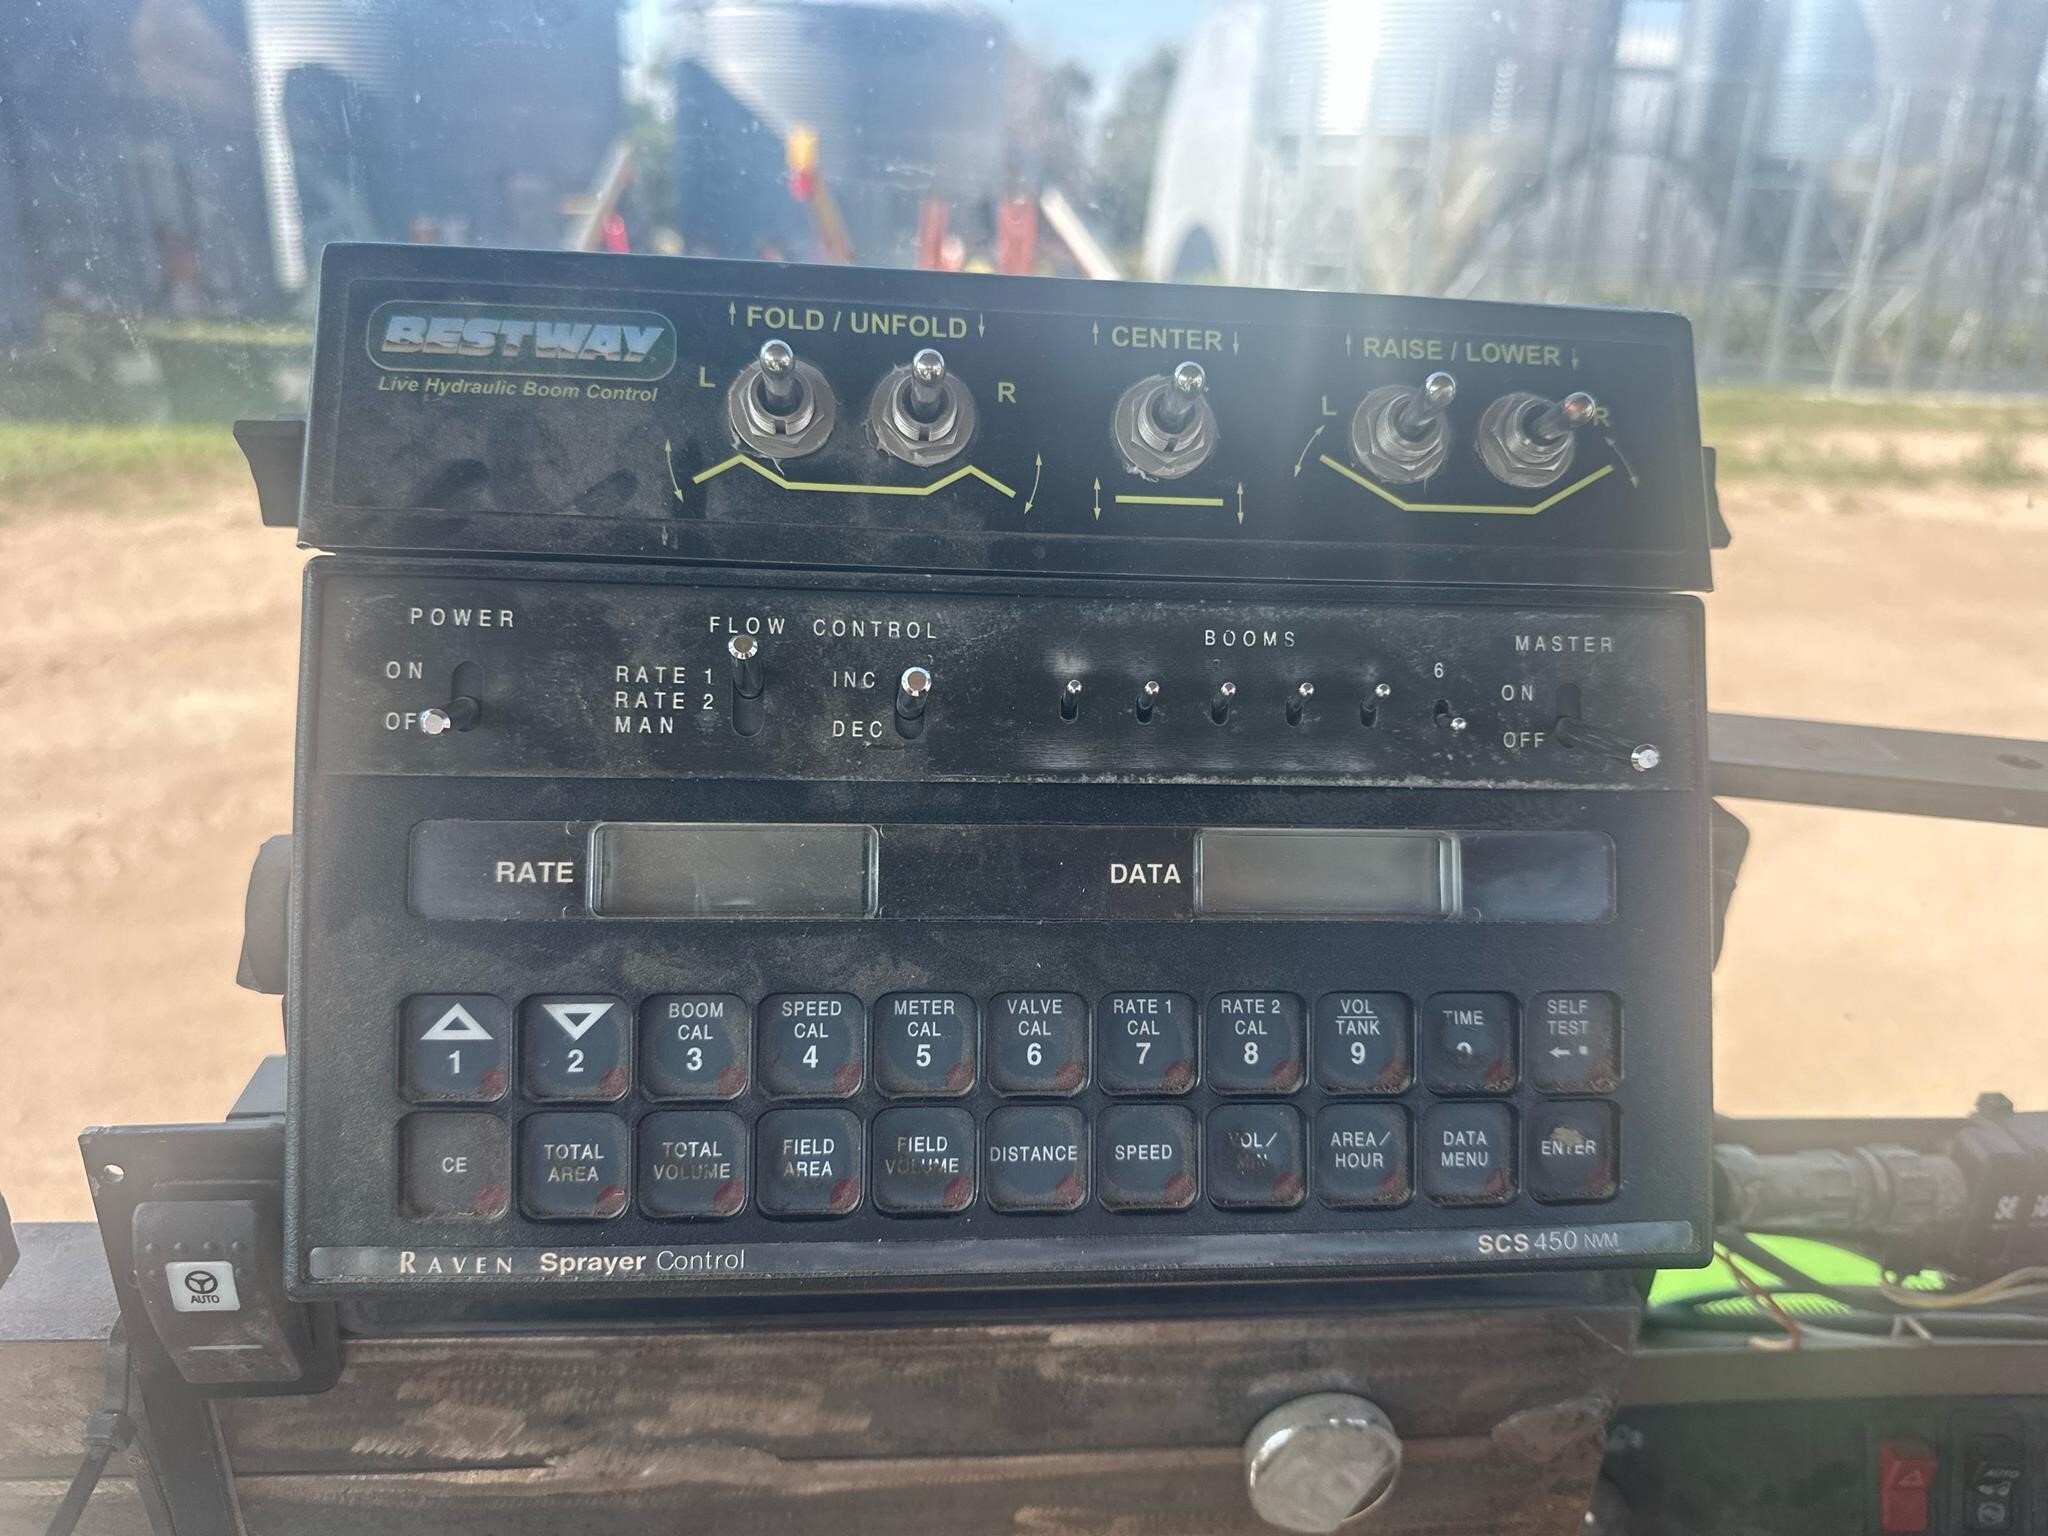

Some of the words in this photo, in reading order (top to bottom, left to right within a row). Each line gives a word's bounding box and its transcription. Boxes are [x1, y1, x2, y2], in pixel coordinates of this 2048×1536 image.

[746, 306, 825, 332] FOLD
[849, 312, 969, 340] UNFOLD
[382, 315, 665, 363] BESTWAY
[1111, 325, 1223, 352] CENTER
[1363, 336, 1443, 362] RAISE
[1465, 342, 1562, 367] LOWER
[700, 366, 716, 388] L
[378, 376, 420, 392] Live
[424, 377, 518, 397] Hydraulic
[522, 381, 580, 398] Boom
[587, 384, 659, 402] Control
[998, 381, 1016, 404] R
[1321, 395, 1337, 417] L
[410, 607, 516, 629] POWER
[709, 615, 787, 637] FLOW
[812, 618, 938, 641] CONTROL
[1204, 628, 1298, 649] BOOMS
[1515, 634, 1615, 655] MASTER
[385, 661, 424, 681] ON
[615, 665, 686, 685] RATE
[704, 669, 713, 685] 1
[1434, 661, 1445, 680] 6
[832, 671, 877, 690] INC
[615, 691, 686, 711] RATE
[702, 693, 715, 711] 2
[1501, 683, 1535, 702] ON
[385, 711, 418, 731] OF
[615, 715, 674, 735] MAN
[832, 720, 884, 740] DEC
[1502, 730, 1546, 750] OFF
[495, 860, 575, 885] RATE
[1109, 862, 1182, 885] DATA
[668, 1001, 724, 1019] BOOM
[781, 1000, 842, 1017] SPEED
[894, 999, 955, 1016] METER
[1007, 998, 1063, 1015] VALVE
[1113, 998, 1158, 1014] RATE
[1165, 999, 1172, 1014] 1
[1220, 999, 1265, 1014] RATE
[1271, 999, 1281, 1014] 2
[1340, 998, 1374, 1015] VOL
[1546, 999, 1589, 1015] SELF
[1442, 1009, 1485, 1025] TIME
[677, 1023, 714, 1041] CAL
[793, 1022, 829, 1039] CAL
[907, 1021, 942, 1038] CAL
[1018, 1020, 1052, 1037] CAL
[1126, 1019, 1161, 1036] CAL
[1234, 1020, 1268, 1036] CAL
[1335, 1019, 1381, 1036] TANK
[1547, 1019, 1589, 1035] TEST
[448, 1051, 462, 1074] 1
[567, 1049, 585, 1073] 2
[686, 1048, 703, 1072] 3
[802, 1045, 819, 1068] 4
[916, 1044, 932, 1067] 5
[1026, 1042, 1043, 1066] 6
[1135, 1042, 1152, 1065] 7
[1243, 1042, 1259, 1065] 8
[1350, 1041, 1366, 1065] 9
[782, 1138, 835, 1155] FIELD
[897, 1135, 949, 1153] FIELD
[1331, 1130, 1391, 1148] AREA/
[1443, 1130, 1487, 1147] DATA
[544, 1143, 605, 1161] TOTAL
[662, 1141, 723, 1158] TOTAL
[990, 1145, 1078, 1163] DISTANCE
[1114, 1144, 1173, 1161] SPEED
[1441, 1151, 1489, 1167] MENU
[442, 1157, 468, 1174] CE
[783, 1161, 833, 1178] AREA
[1335, 1152, 1384, 1168] HOUR
[547, 1166, 600, 1183] AREA
[653, 1162, 731, 1180] VOLUME
[1477, 1233, 1529, 1254] SCS
[1534, 1230, 1577, 1251] 450
[400, 1250, 513, 1274] RAVEN
[539, 1252, 647, 1276] Sprayer
[656, 1249, 746, 1272] Control
[190, 1294, 220, 1304] AUTO
